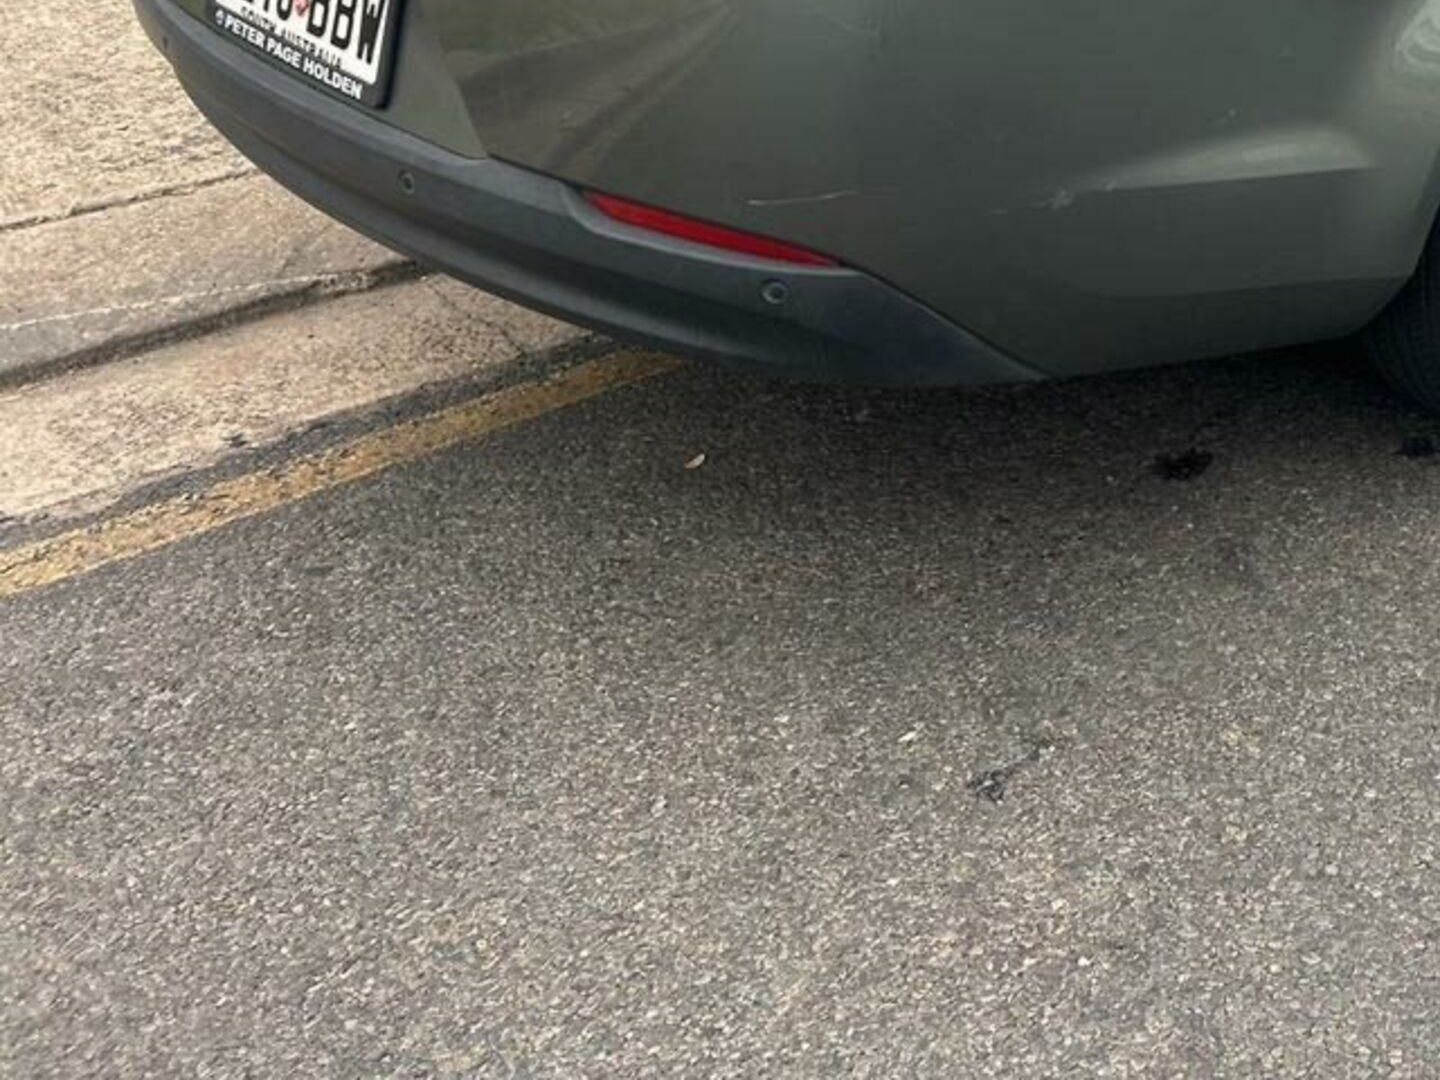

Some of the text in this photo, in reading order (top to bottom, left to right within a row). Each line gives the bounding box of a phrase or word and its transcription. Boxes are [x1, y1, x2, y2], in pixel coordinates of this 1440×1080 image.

[224, 14, 364, 100] PETER PAGE HOLDEN
